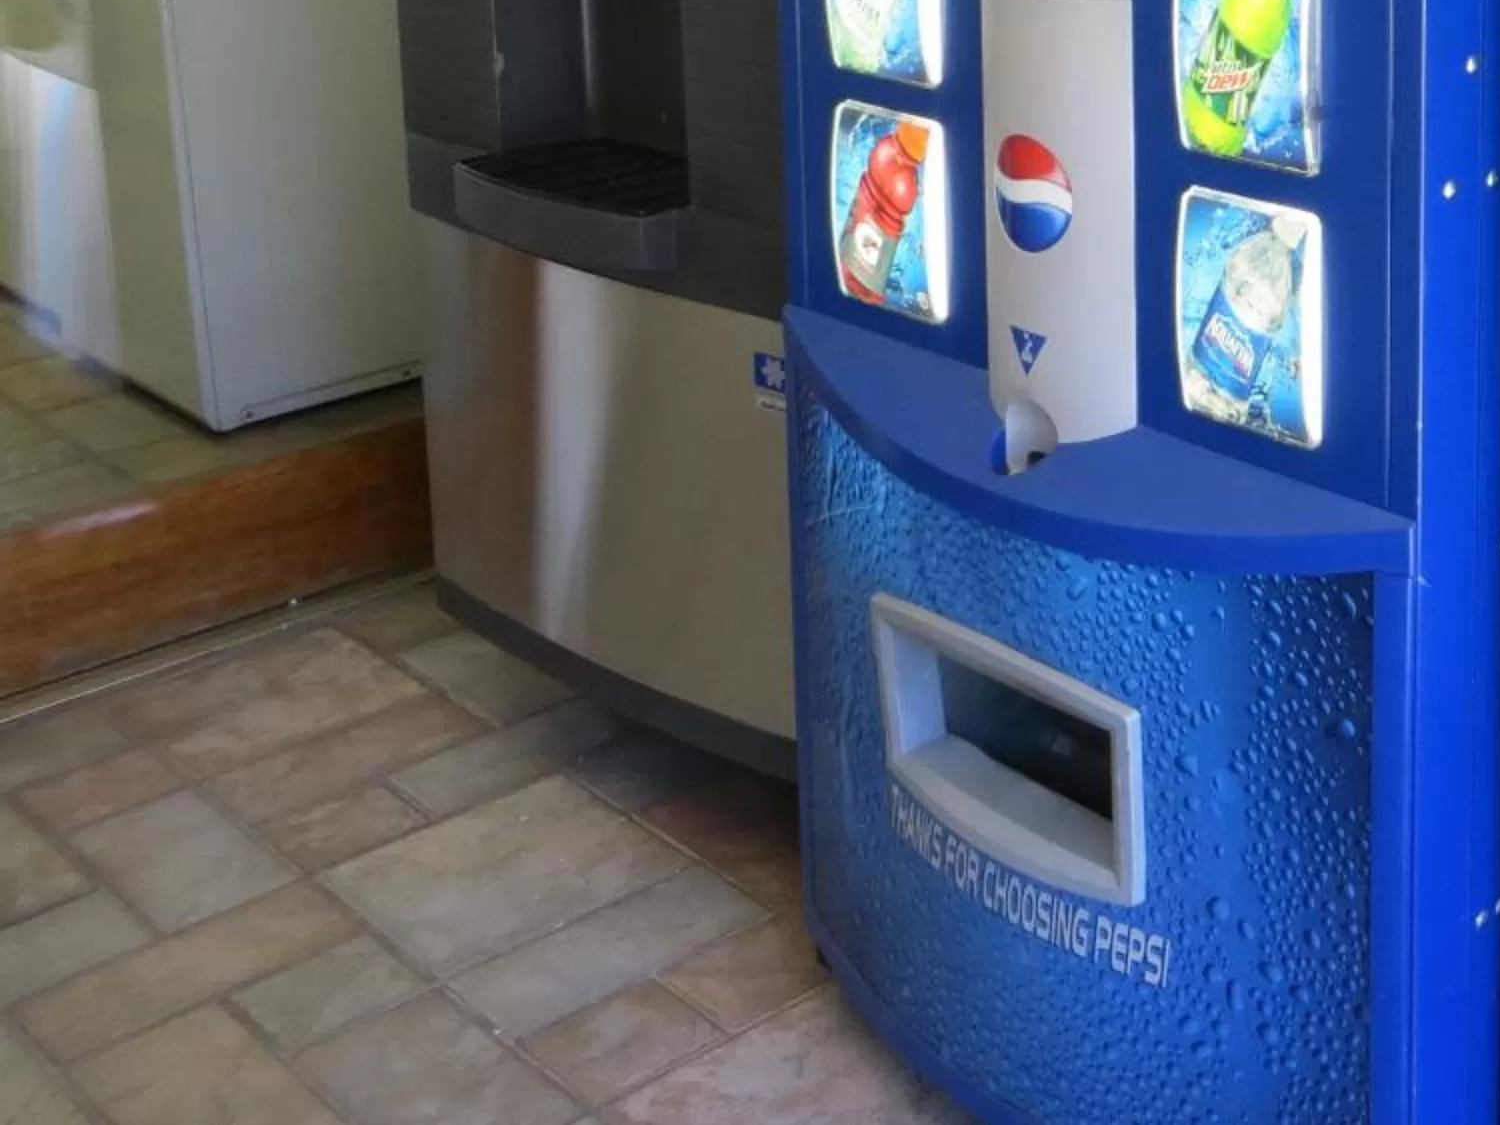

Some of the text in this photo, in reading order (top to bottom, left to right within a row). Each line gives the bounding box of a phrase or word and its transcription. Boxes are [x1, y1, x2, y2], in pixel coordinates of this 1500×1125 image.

[889, 782, 1171, 989] THANKS FOR CHOOSING PEPSI
